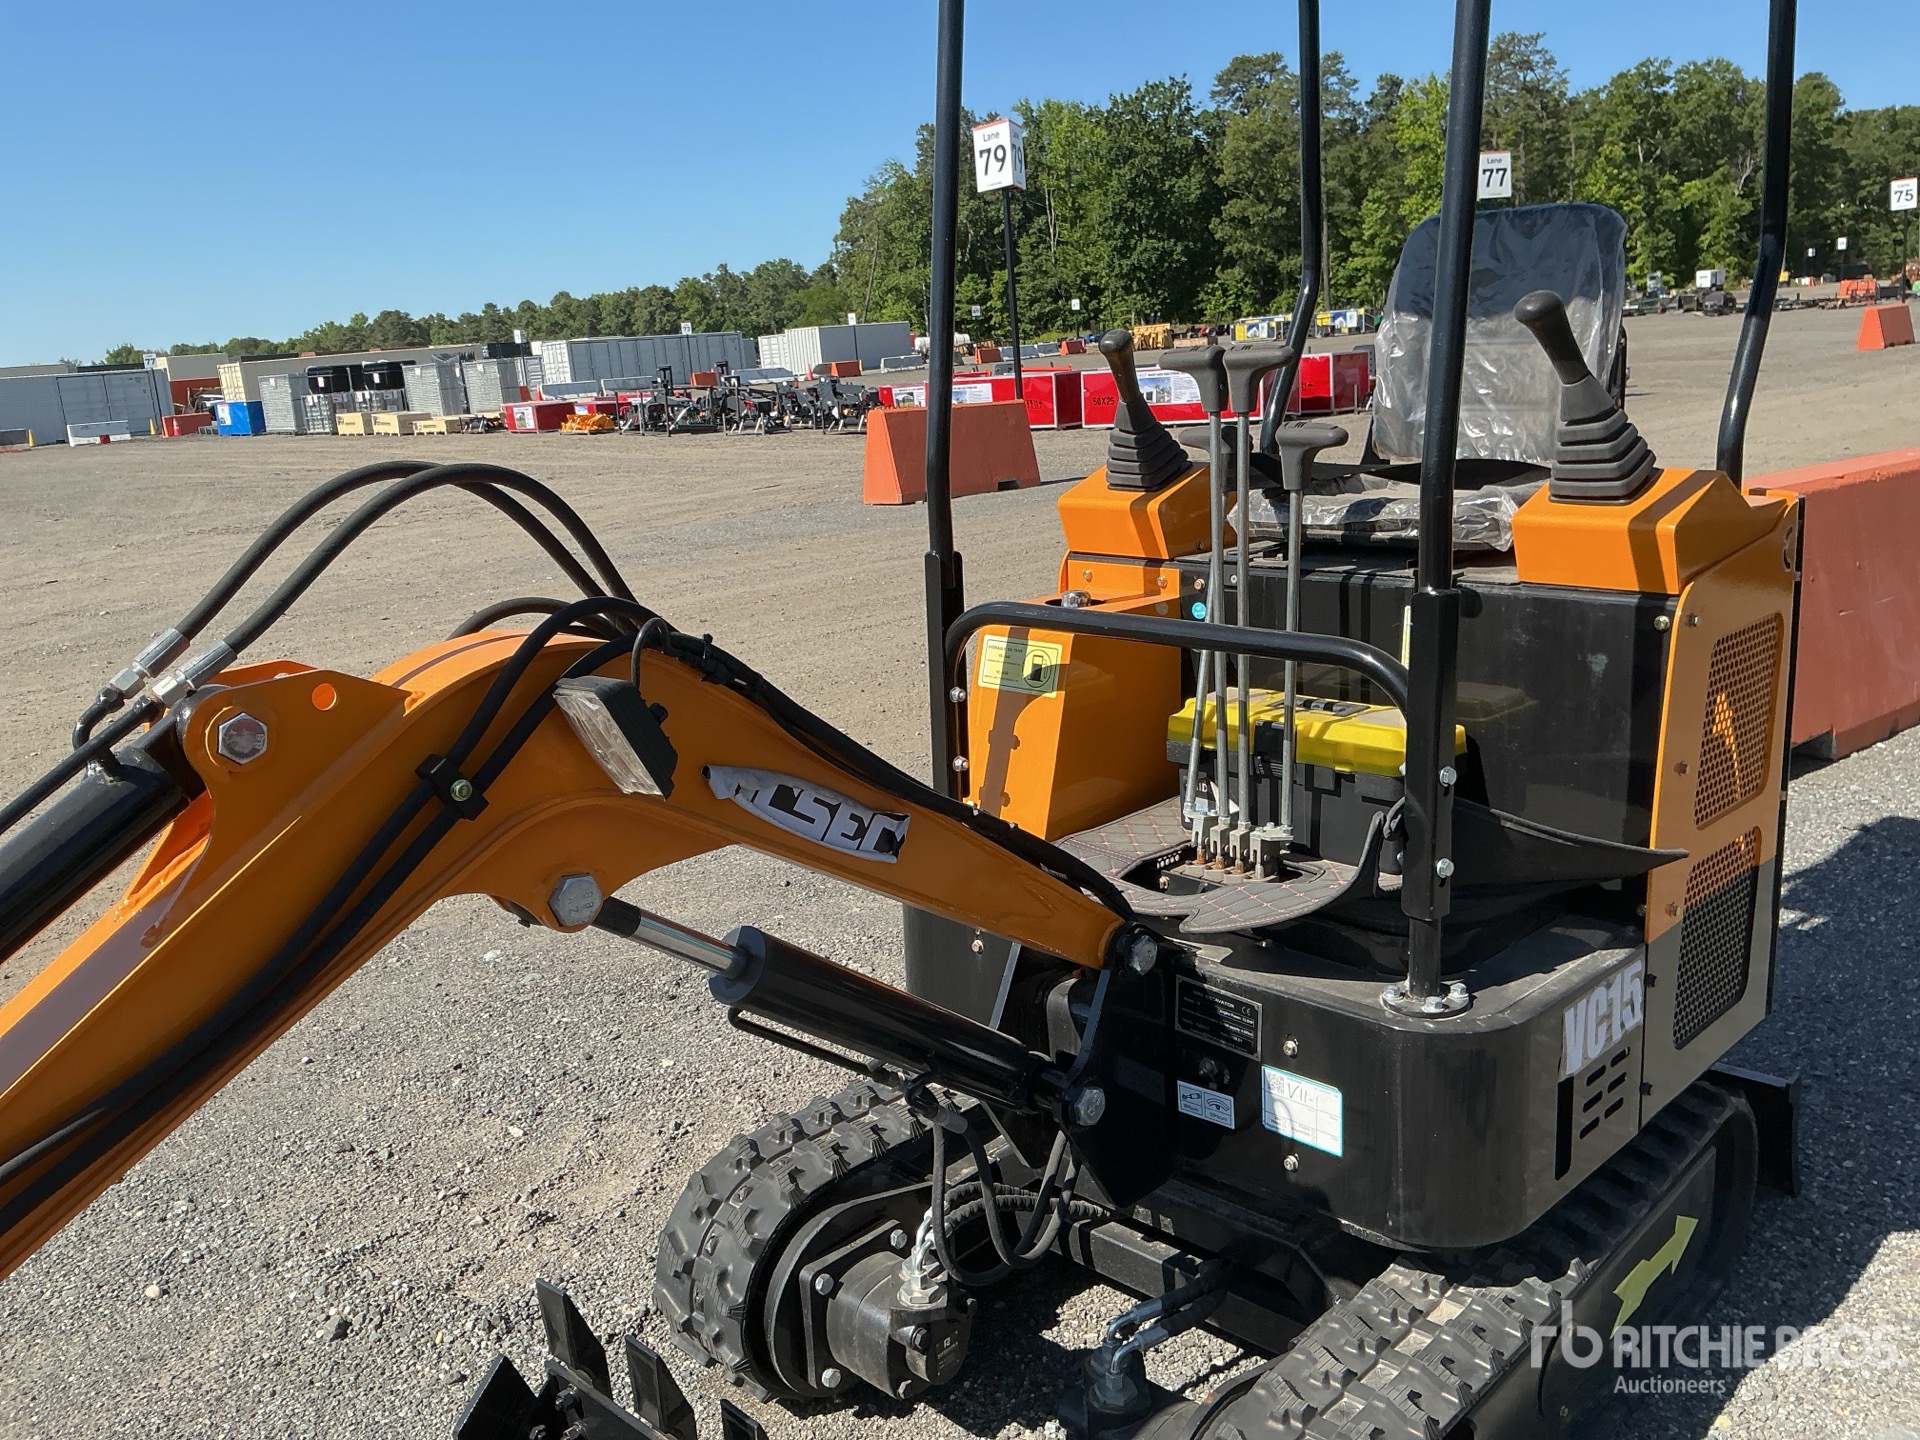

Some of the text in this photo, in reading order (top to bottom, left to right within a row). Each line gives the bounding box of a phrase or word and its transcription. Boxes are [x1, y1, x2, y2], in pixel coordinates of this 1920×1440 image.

[983, 131, 1000, 142] Lane
[979, 144, 1007, 176] 79
[1487, 157, 1503, 165] Lane
[1482, 167, 1507, 188] 77
[1894, 188, 1914, 203] 75
[145, 358, 156, 366] 77
[1092, 396, 1115, 406] 50X25
[1564, 959, 1644, 1075] VC15
